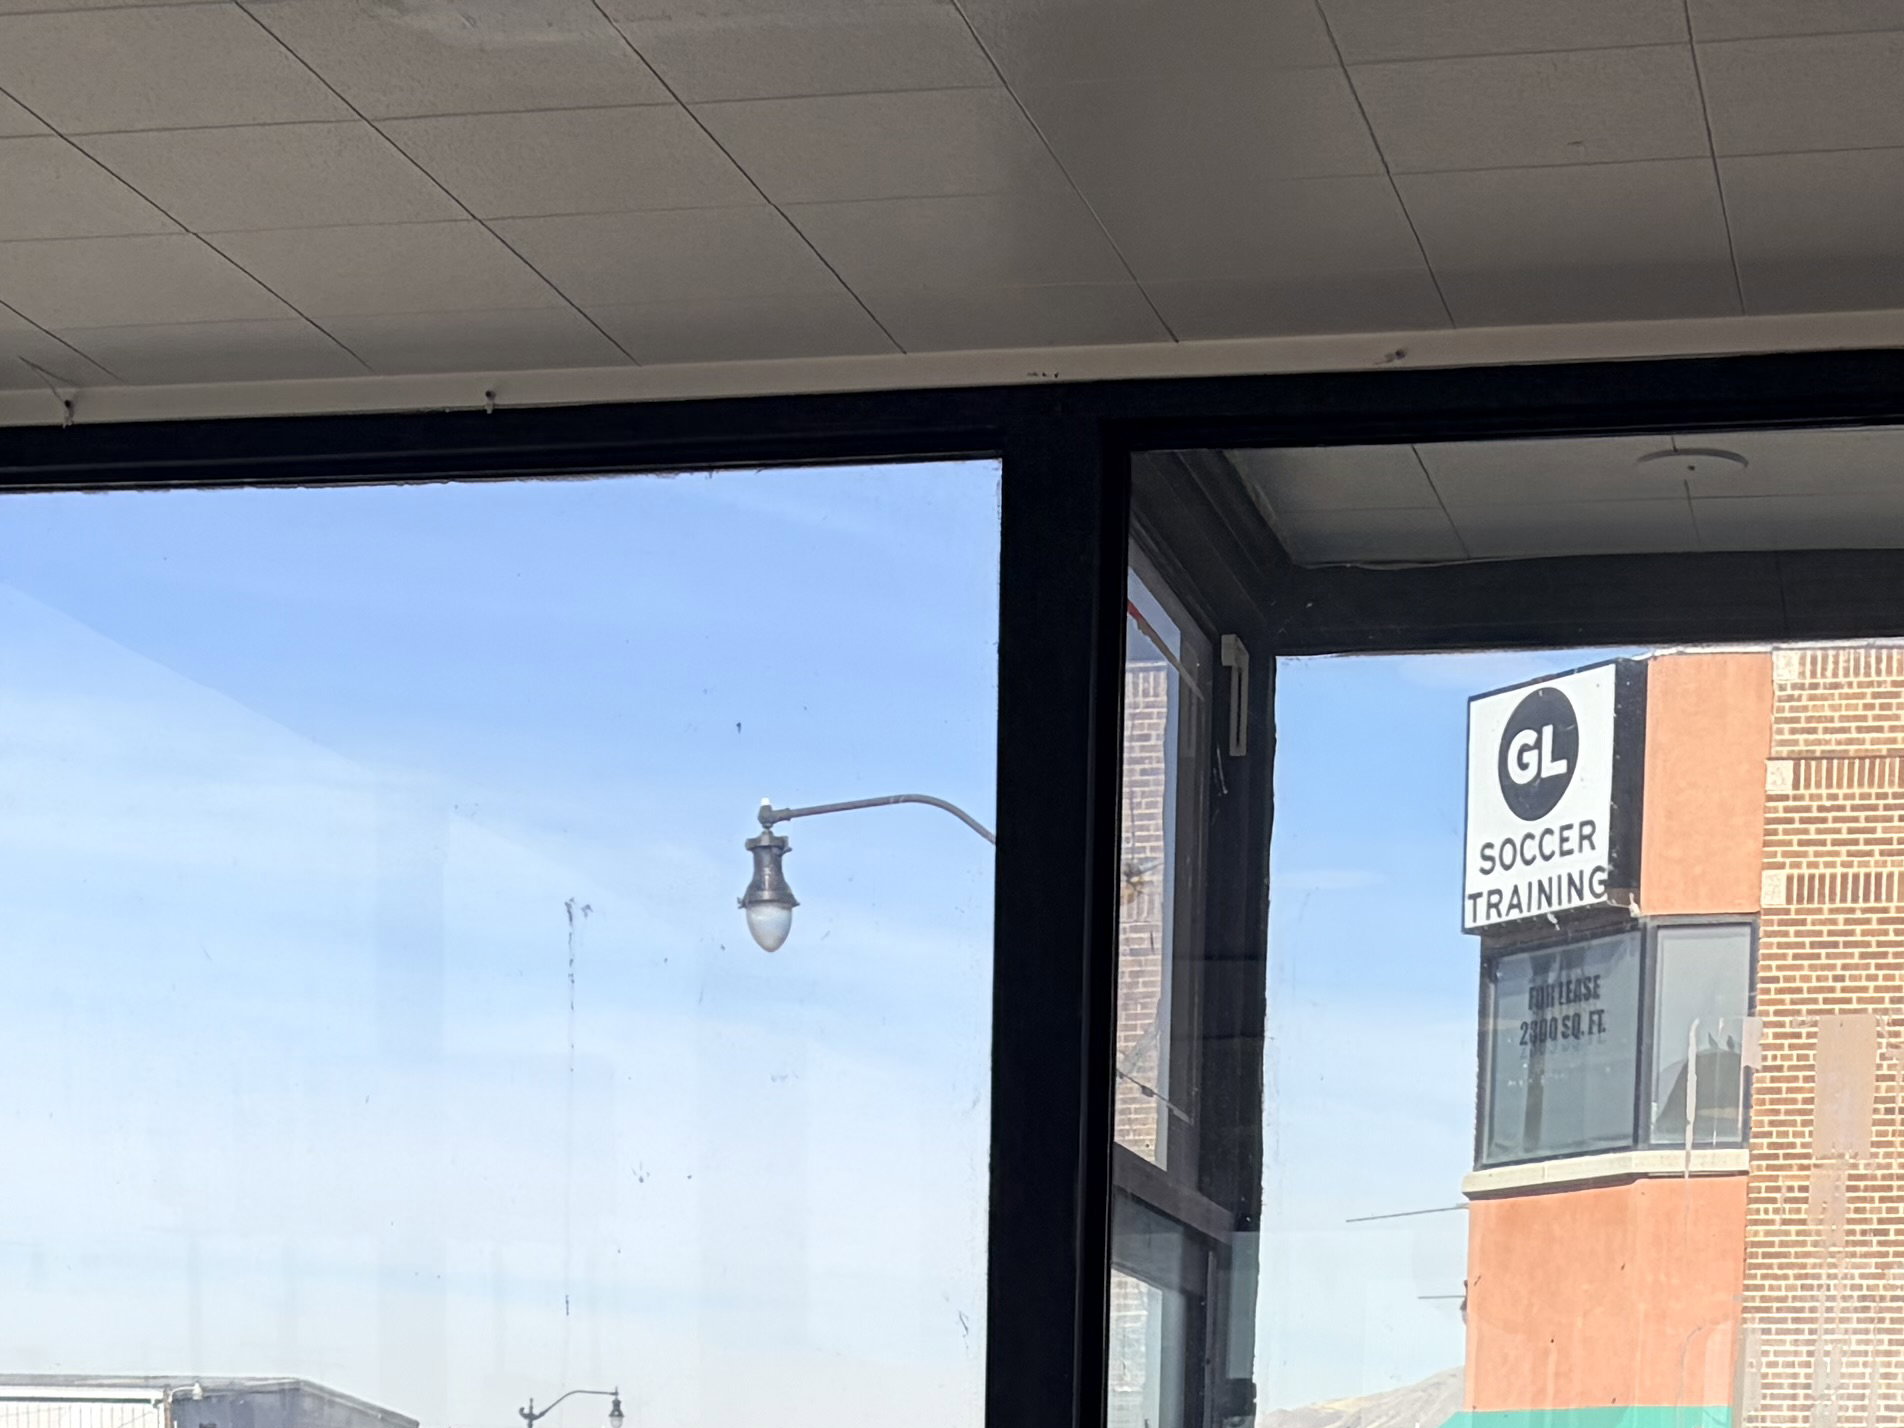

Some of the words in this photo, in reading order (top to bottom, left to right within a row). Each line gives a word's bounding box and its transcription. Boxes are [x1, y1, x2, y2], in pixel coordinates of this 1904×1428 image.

[1507, 724, 1568, 785] GL
[1479, 819, 1597, 876] SOCCER
[1467, 865, 1609, 924] TRAINING
[1528, 983, 1556, 1011] FOR
[1558, 974, 1601, 1006] LEASE
